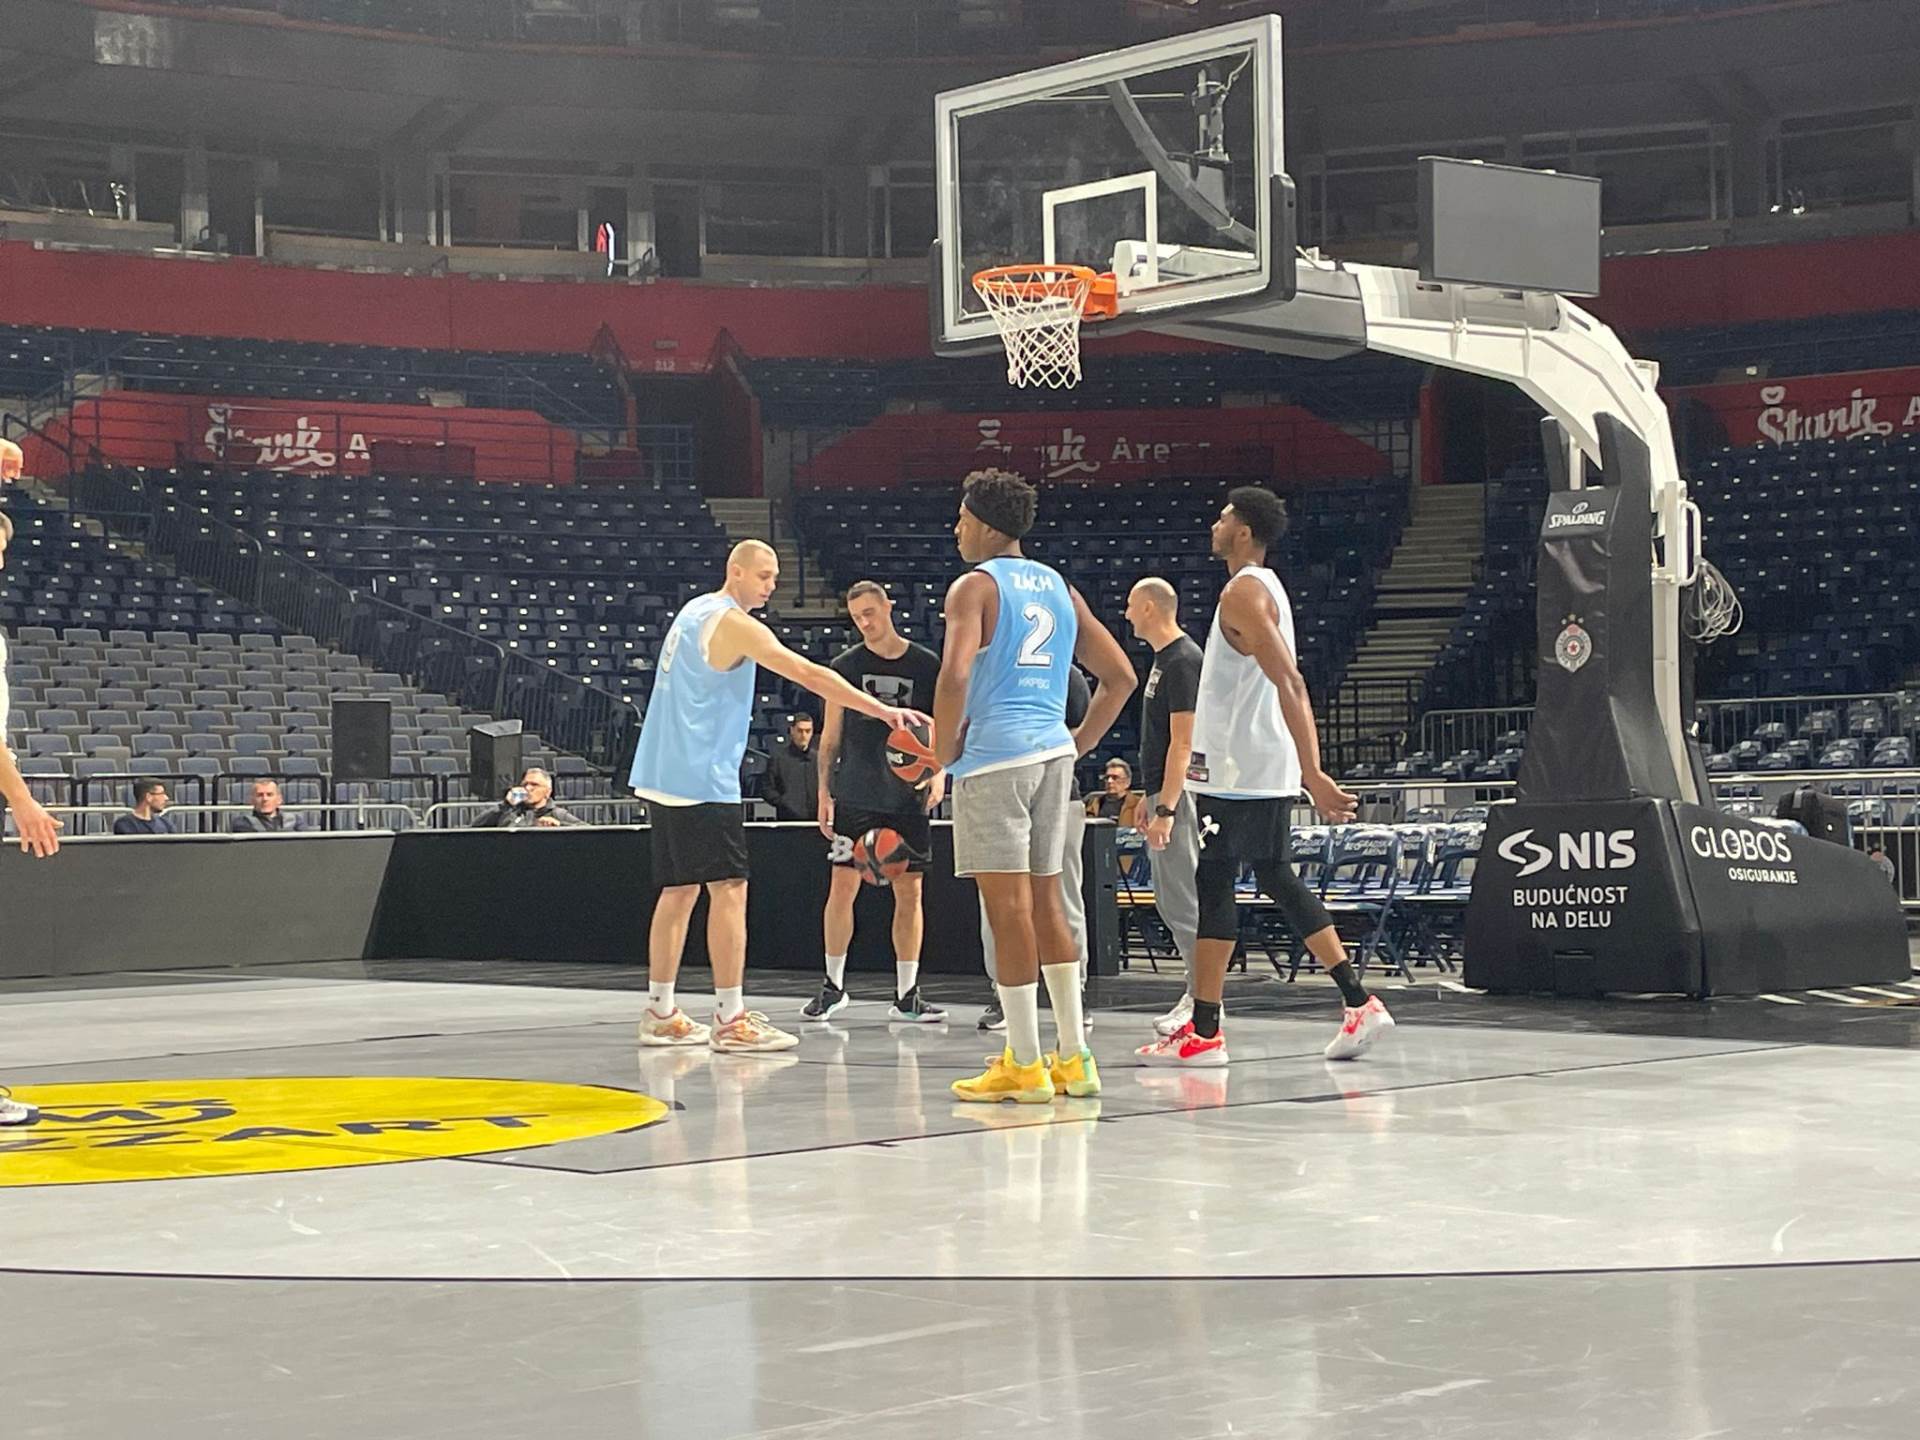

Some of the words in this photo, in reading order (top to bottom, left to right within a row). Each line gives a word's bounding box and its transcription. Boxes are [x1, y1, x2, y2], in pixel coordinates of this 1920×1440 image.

[1549, 510, 1606, 528] SPALDING
[1017, 602, 1056, 668] 2
[1559, 829, 1636, 870] NIS
[1691, 826, 1792, 863] GLOBOS
[1728, 867, 1798, 885] OSIGURANJE
[1513, 884, 1628, 906] BUDUĆNOST
[1531, 912, 1558, 928] NA
[1565, 910, 1612, 928] DELU
